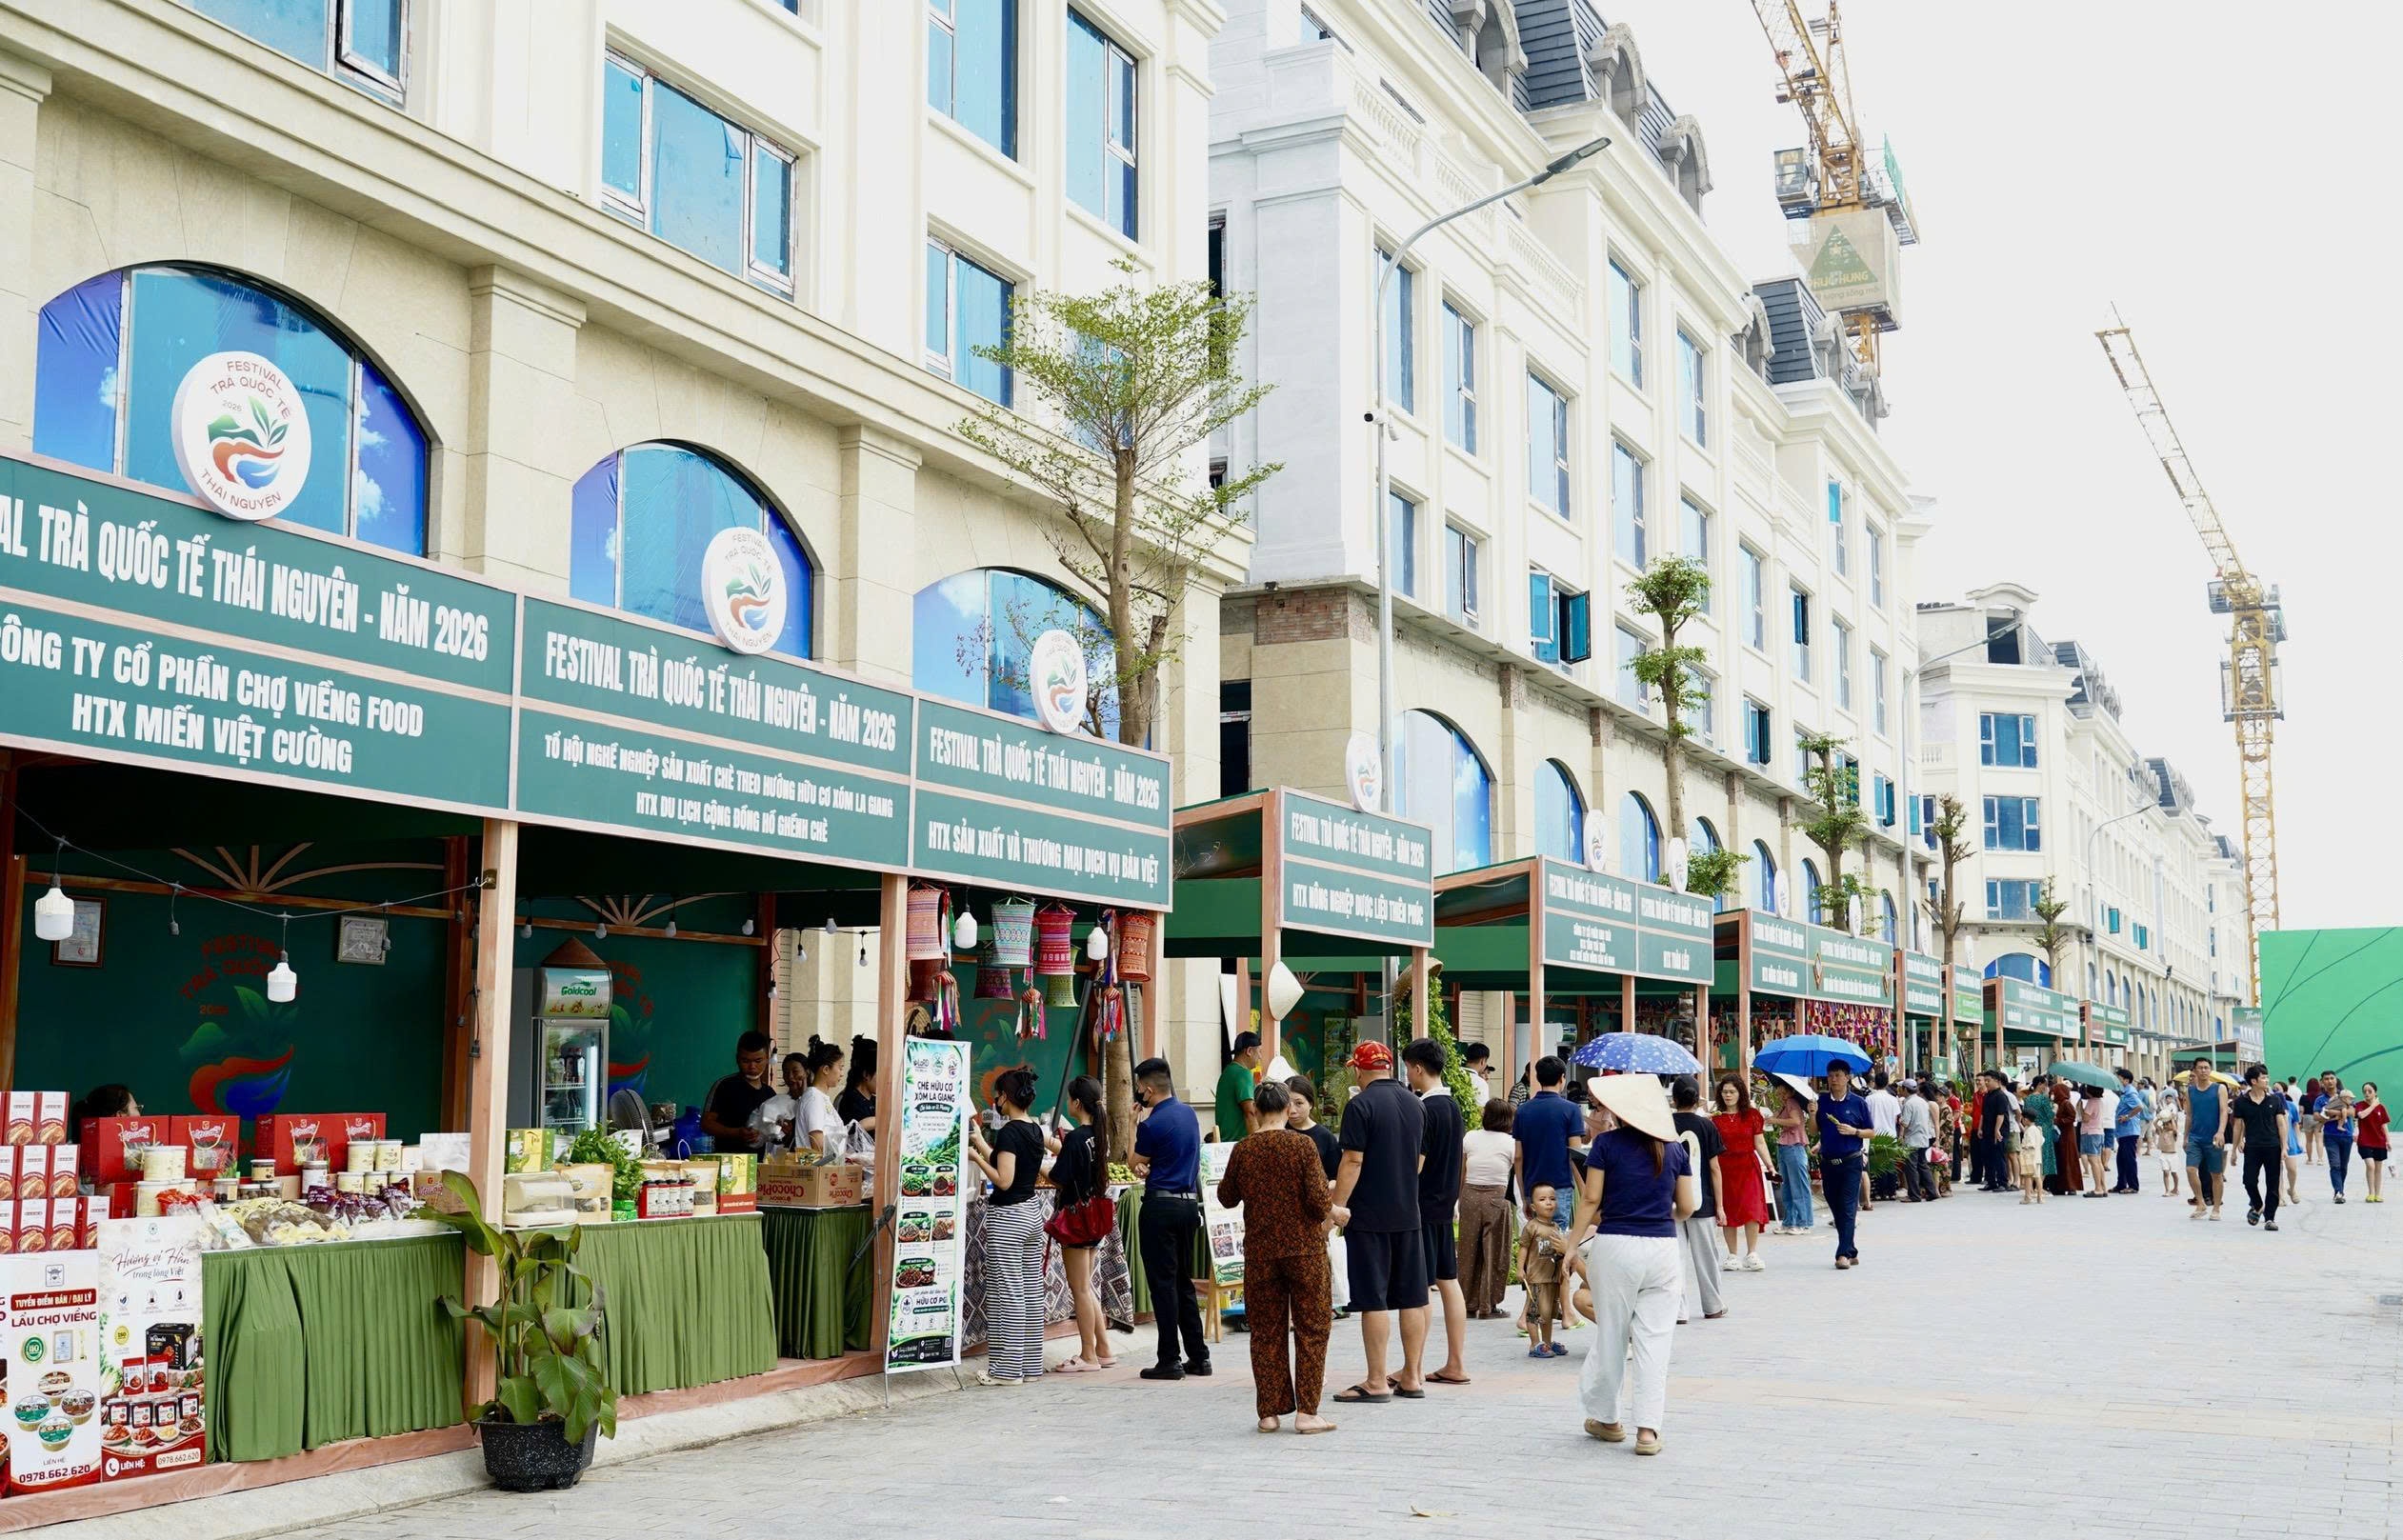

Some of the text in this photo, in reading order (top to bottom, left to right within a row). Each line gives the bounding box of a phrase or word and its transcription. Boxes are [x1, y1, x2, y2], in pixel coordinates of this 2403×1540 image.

[227, 361, 283, 390] FESTIVAL
[39, 500, 89, 571] TRÀ
[98, 521, 169, 589] QUỐC
[177, 534, 213, 597] TẾ
[212, 546, 265, 610] THÁI
[271, 564, 358, 632] NGUYÊN
[364, 613, 374, 624] -
[380, 584, 430, 649] NĂM
[434, 606, 488, 661] 2026
[0, 614, 423, 736] ÔNG TY CỔ PHẦN CHỢ VIỀNG FOOD
[546, 630, 623, 692] FESTIVAL
[629, 645, 657, 700] TRÀ
[663, 655, 704, 710] QUỐC
[709, 663, 728, 714] TẾ
[730, 670, 760, 722] THÁI
[765, 683, 816, 734] NGUYÊN
[830, 692, 859, 744] NĂM
[863, 708, 895, 751] 2026
[72, 693, 352, 773] HTX MIẾN VIỆT CƯỜNG
[930, 727, 980, 771] FESTIVAL
[982, 732, 1003, 776] TRÀ
[1004, 740, 1032, 783] QUỐC
[1033, 745, 1048, 786] TẾ
[1047, 750, 1070, 791] THÁI
[1070, 756, 1106, 799] NGUYÊN
[1113, 764, 1135, 806] NĂM
[1136, 774, 1160, 810] 2026
[929, 817, 1159, 889] HTX SẢN XUẤT VÀ THƯƠNG MẠI DỊCH VỤ BẢN VIỆT
[561, 986, 597, 996] Goldcool
[37, 1313, 61, 1326] CHỢ
[19, 1464, 90, 1484] 0978.662.620
[157, 1451, 200, 1466] 0978.662.620
